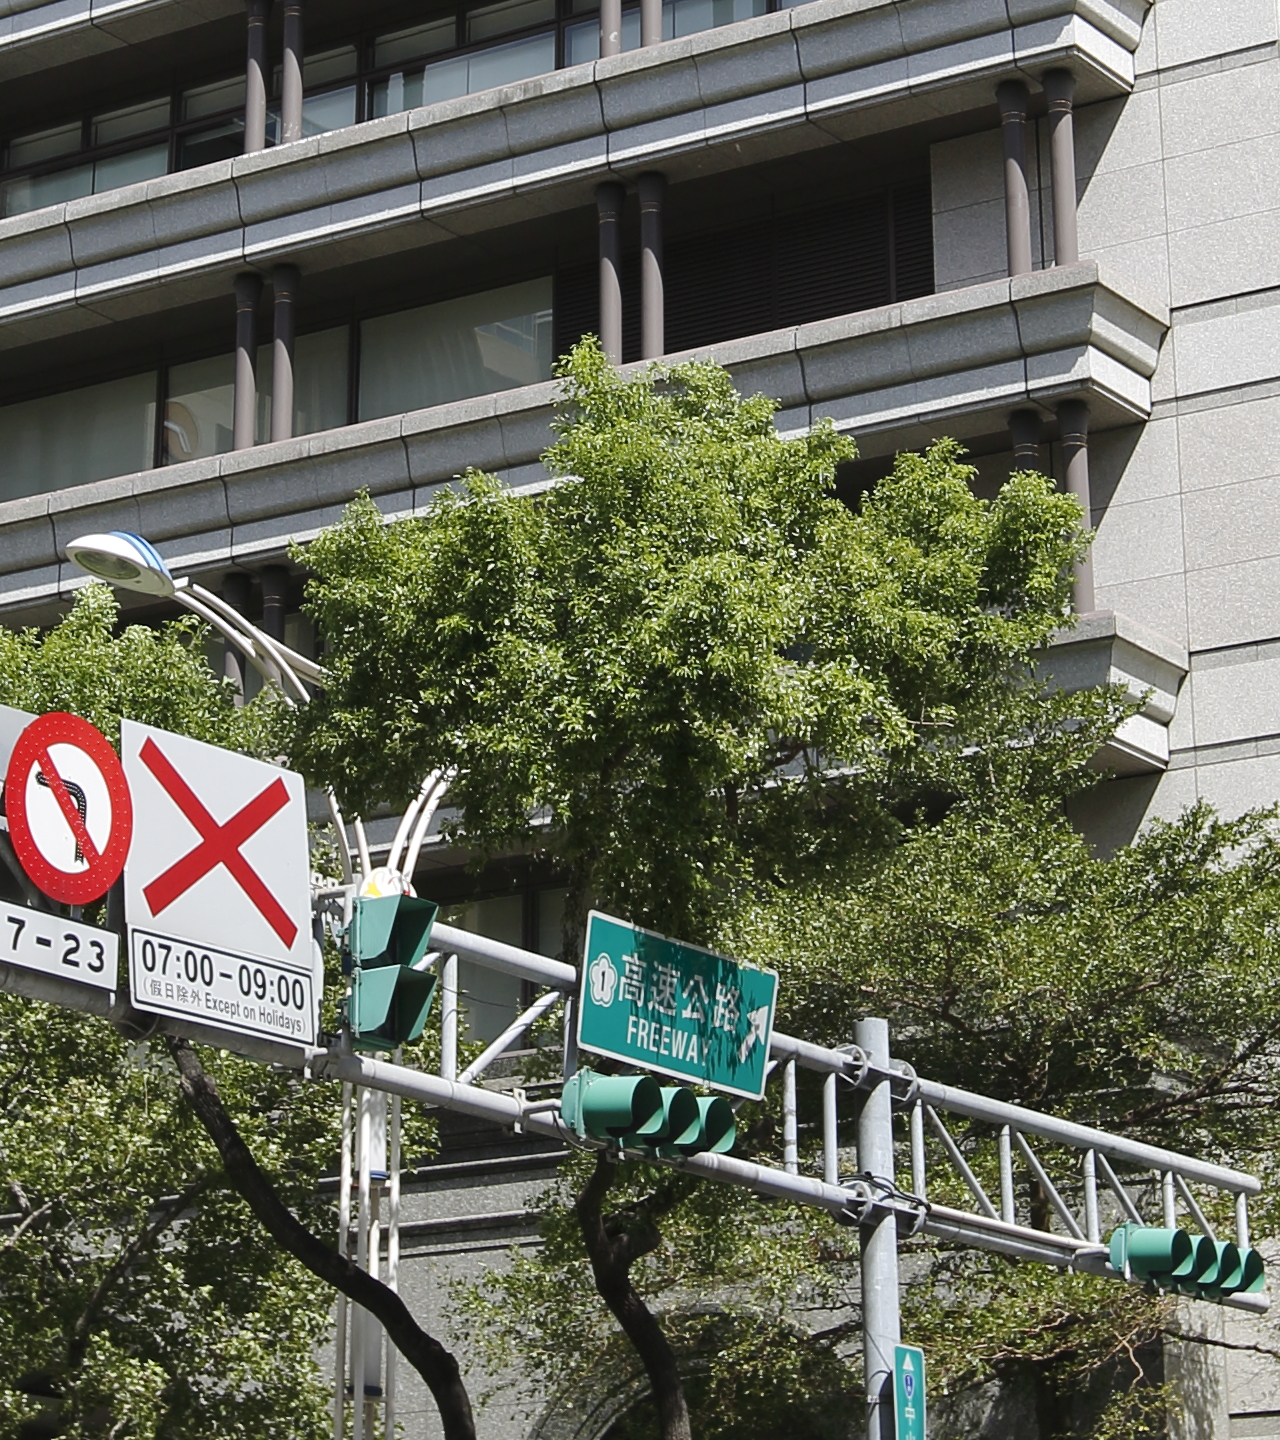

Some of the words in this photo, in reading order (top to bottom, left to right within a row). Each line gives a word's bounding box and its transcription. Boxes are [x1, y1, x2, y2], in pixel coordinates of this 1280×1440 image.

[6, 915, 105, 973] 7-23
[205, 992, 241, 1021] Except
[243, 1006, 257, 1021] on
[258, 1005, 306, 1035] Holidays)
[618, 952, 740, 1033] 高速公路
[626, 1015, 712, 1067] FREEWAY
